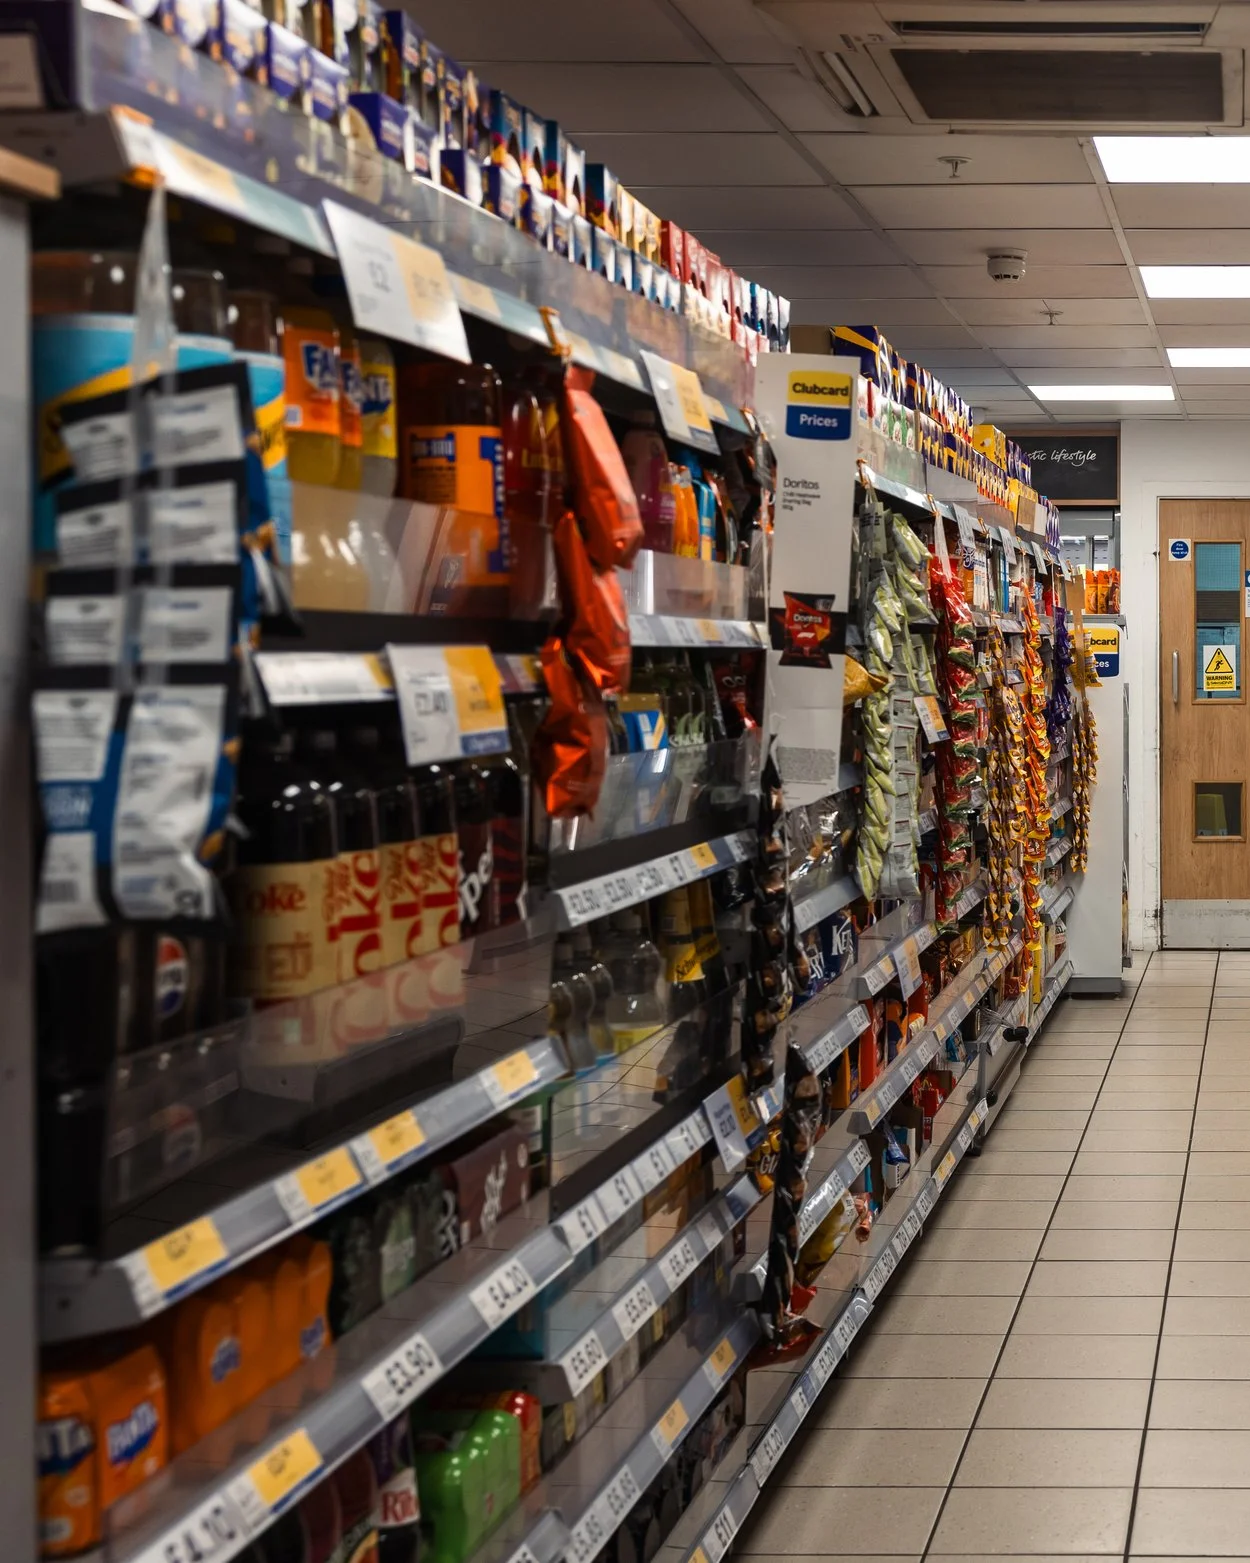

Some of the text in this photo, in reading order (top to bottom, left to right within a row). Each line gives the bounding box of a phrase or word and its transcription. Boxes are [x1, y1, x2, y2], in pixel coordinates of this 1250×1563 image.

[792, 381, 849, 398] Clubcard
[800, 412, 838, 428] Prices
[1051, 448, 1097, 467] lifestyle
[783, 477, 820, 490] Doritos
[793, 613, 822, 624] Doritos
[1090, 637, 1117, 646] bcard
[714, 1514, 735, 1545] £11
